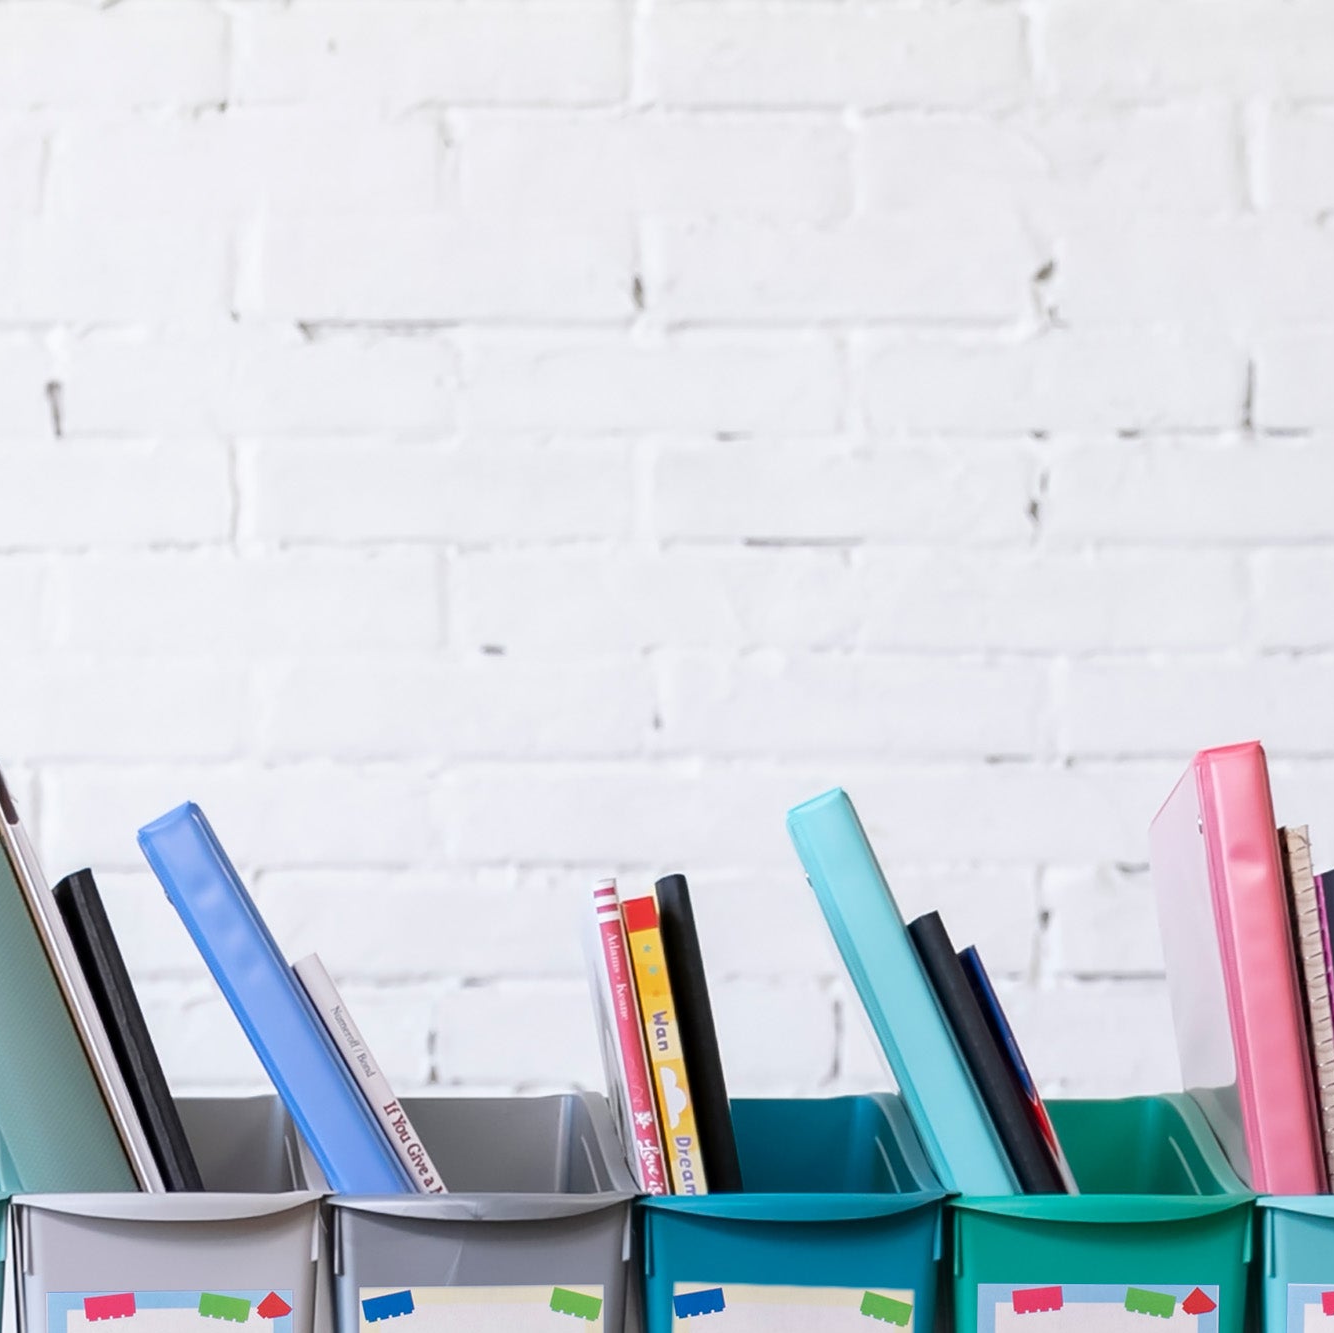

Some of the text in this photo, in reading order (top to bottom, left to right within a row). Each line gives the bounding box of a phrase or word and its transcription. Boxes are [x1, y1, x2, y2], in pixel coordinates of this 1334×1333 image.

[607, 932, 621, 973] Adams
[652, 1010, 669, 1052] Wan
[356, 1052, 377, 1078] Bond
[383, 1100, 435, 1187] If You Give a
